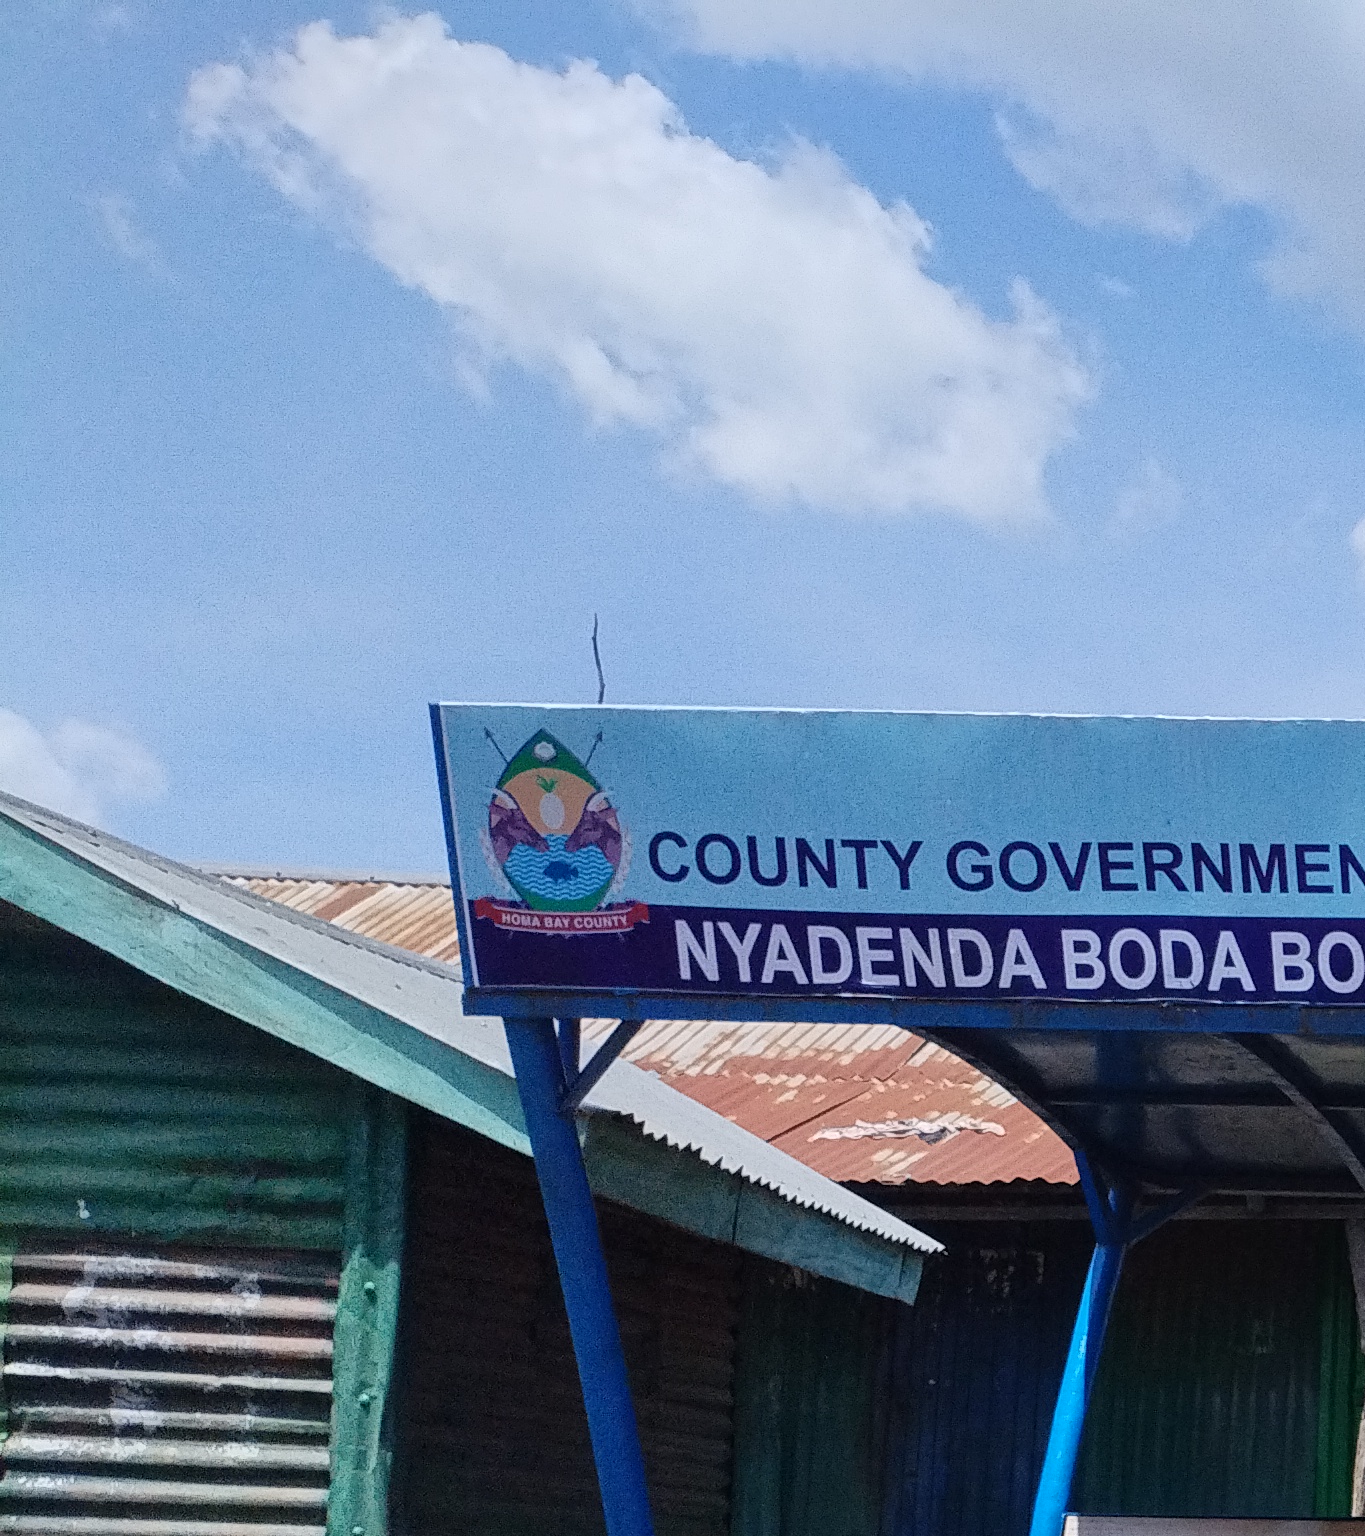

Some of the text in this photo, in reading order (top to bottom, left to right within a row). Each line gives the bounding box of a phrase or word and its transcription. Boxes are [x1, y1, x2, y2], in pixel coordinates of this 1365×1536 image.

[648, 831, 923, 891] COUNTY
[502, 914, 627, 929] HOMA BAY COUNTY
[673, 918, 1048, 991] NYADENDA
[1060, 927, 1256, 993] BODA
